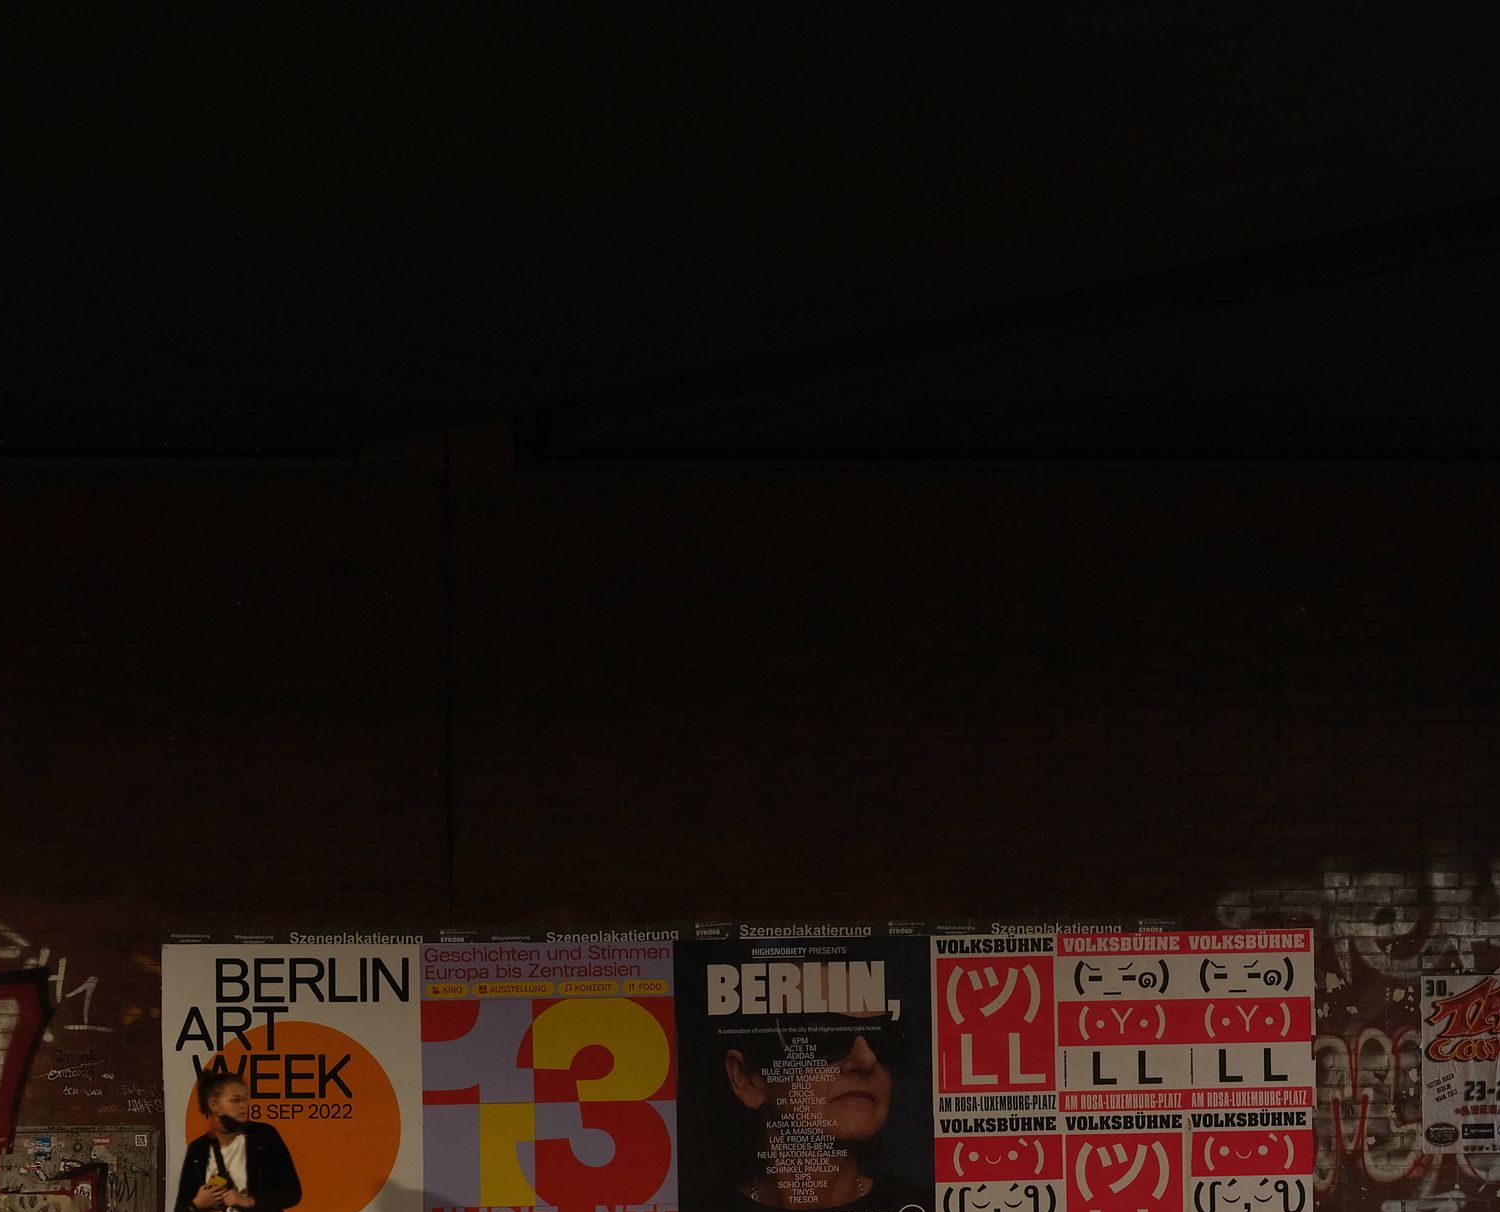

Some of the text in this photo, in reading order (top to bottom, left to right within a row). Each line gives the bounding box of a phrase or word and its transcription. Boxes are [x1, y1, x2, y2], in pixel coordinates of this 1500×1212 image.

[936, 935, 1054, 954] VOLKSBÜHNE
[1063, 933, 1180, 953] VOLKSBÜHNE
[1188, 931, 1305, 951] VOLKSBÜHNE
[425, 945, 670, 963] Geschichten und Stimmen
[752, 947, 847, 956] HIGHSNOBIETY PRESENTS
[216, 958, 409, 1002] BERLIN
[425, 963, 640, 981] Europa bis Zentralasien
[490, 985, 546, 993] AUSSTELLUNG
[575, 983, 612, 991] KONZERT
[707, 960, 900, 1021] BERLIN,
[1426, 980, 1454, 996] 30.
[176, 1007, 288, 1051] ART
[940, 1094, 1056, 1112] AM ROSA-LUXEMBURG-PLATZ
[1065, 1092, 1182, 1110] AM ROSA-LUXEMBURG-PLATZ
[1192, 1090, 1307, 1108] AM ROSA-LUXEMBURG-PLATZ
[267, 1104, 352, 1119] SEP 2022
[1192, 1110, 1306, 1128] VOLKSBÜHNE
[940, 1114, 1056, 1134] VOLKSBÜHNE
[1067, 1112, 1182, 1131] VOLKSBÜHNE
[780, 1150, 848, 1158] NATIONALGALERIE
